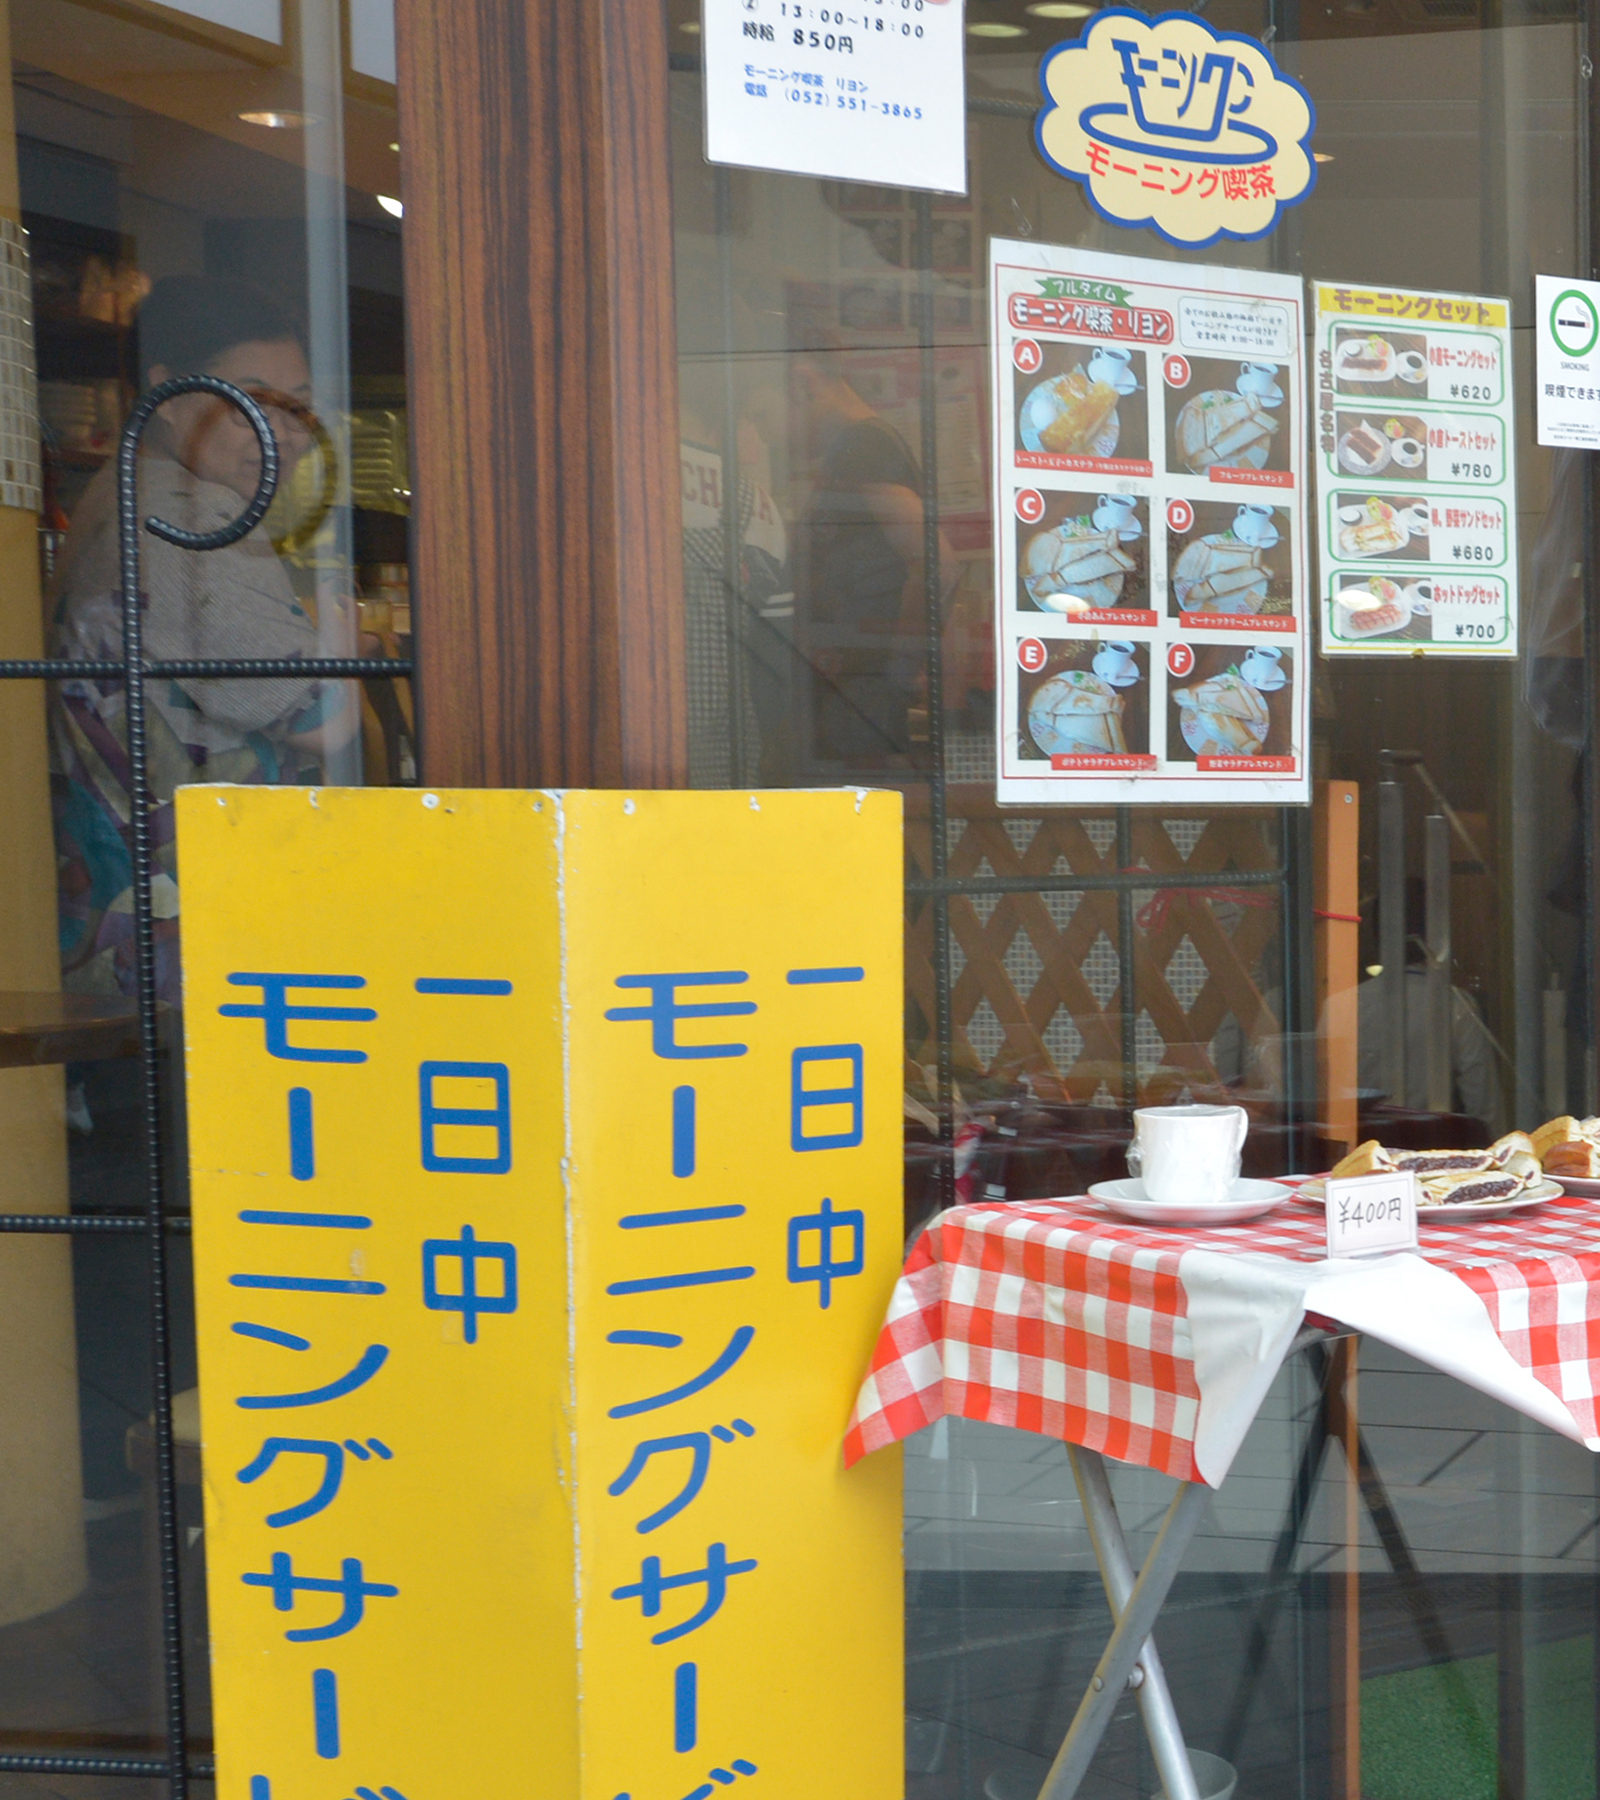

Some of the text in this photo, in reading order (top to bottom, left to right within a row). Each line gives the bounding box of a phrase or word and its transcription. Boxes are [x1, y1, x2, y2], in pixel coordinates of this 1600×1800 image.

[792, 28, 854, 54] 850円
[743, 63, 869, 93] モーニング喫茶 リヨン
[1084, 140, 1277, 202] モーニング喫茶
[1051, 278, 1118, 304] フルタイム
[1333, 288, 1491, 325] モーニングセット
[1012, 295, 1170, 342] モーニング喫茶・リヨン
[1017, 346, 1036, 365] A
[1169, 361, 1185, 380] B
[1560, 361, 1591, 372] SMOKING
[1450, 383, 1492, 400] ¥620
[1451, 462, 1492, 478] ¥780
[1021, 496, 1037, 515] C
[1172, 506, 1187, 525] D
[1452, 545, 1494, 561] ¥680
[1433, 584, 1501, 606] ホットドッグセット
[1455, 624, 1496, 639] ¥700
[1024, 645, 1039, 664] E
[1173, 650, 1186, 669] F
[785, 965, 866, 1310] 一日中
[415, 976, 519, 1344] 一日中
[1337, 1196, 1402, 1235] ¥400円
[217, 970, 411, 1800] モーニングサー
